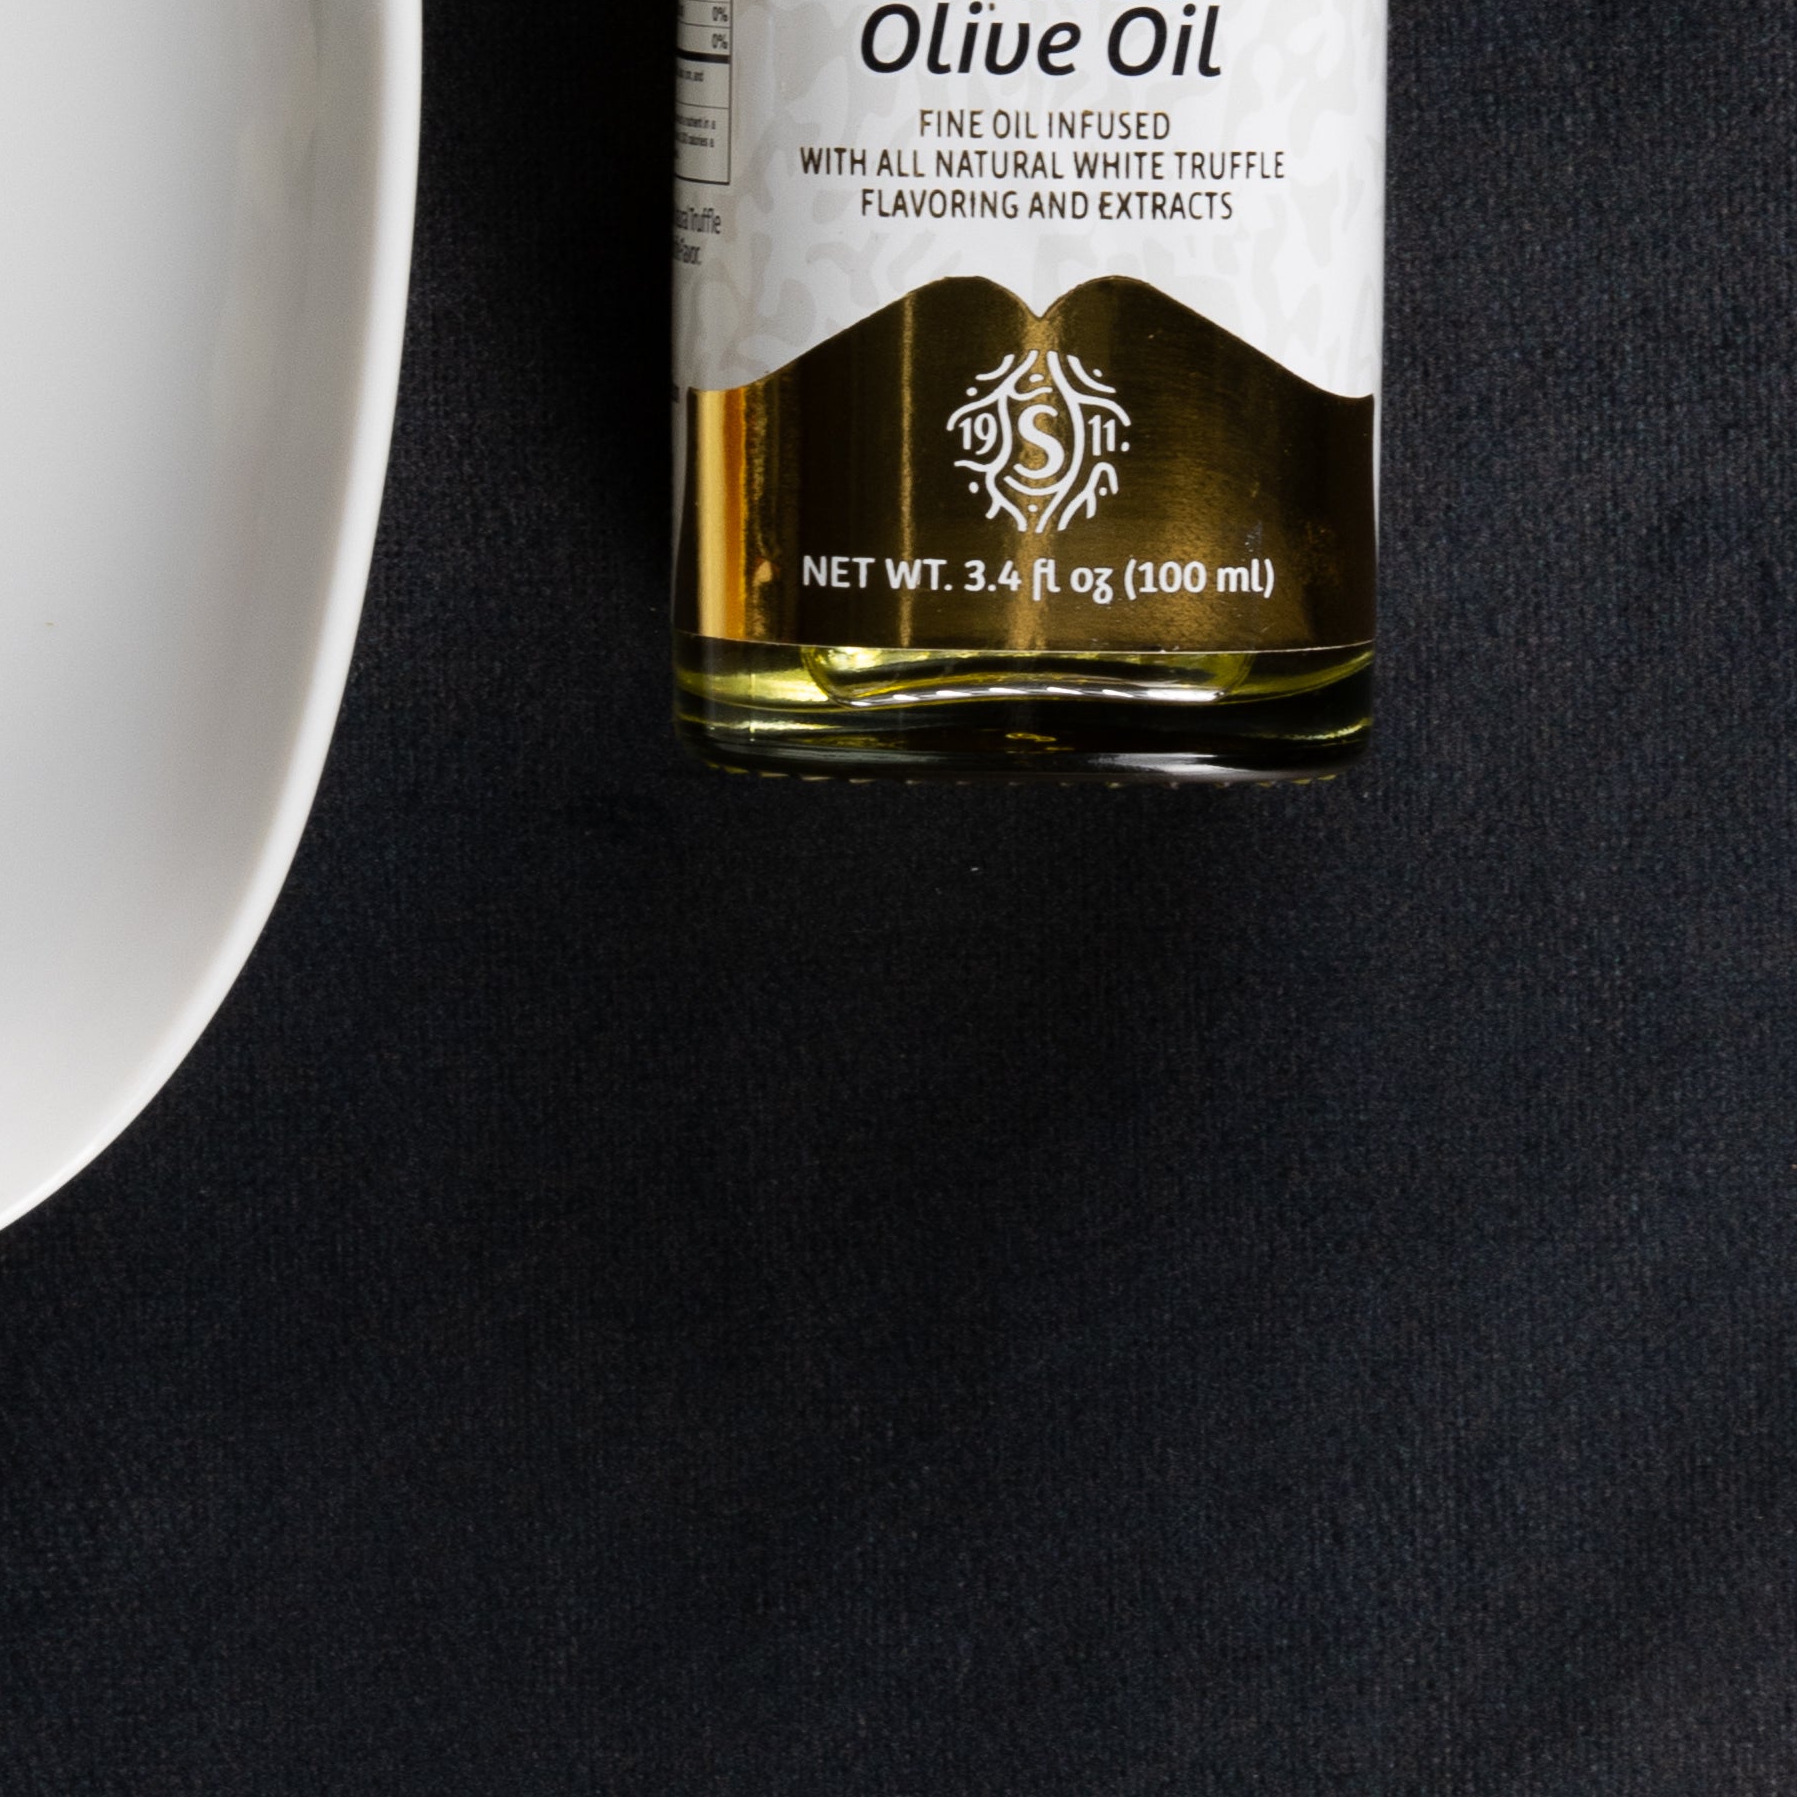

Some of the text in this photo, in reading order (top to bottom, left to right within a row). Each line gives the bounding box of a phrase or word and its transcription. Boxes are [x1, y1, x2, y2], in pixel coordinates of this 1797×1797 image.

[712, 6, 728, 22] 0%
[712, 34, 728, 49] 0%
[861, 1, 1221, 77] Olive Oil
[920, 109, 1170, 140] FINE OIL INFUSED
[800, 147, 1284, 180] WITH ALL NATURAL WHITE TRUFFLE
[862, 188, 1232, 220] FLAVORING AND EXTRACTS
[958, 410, 996, 454] 19
[1015, 405, 1067, 479] S
[805, 557, 1273, 603] NET WT. 3.4 fl oz (100 ml)
